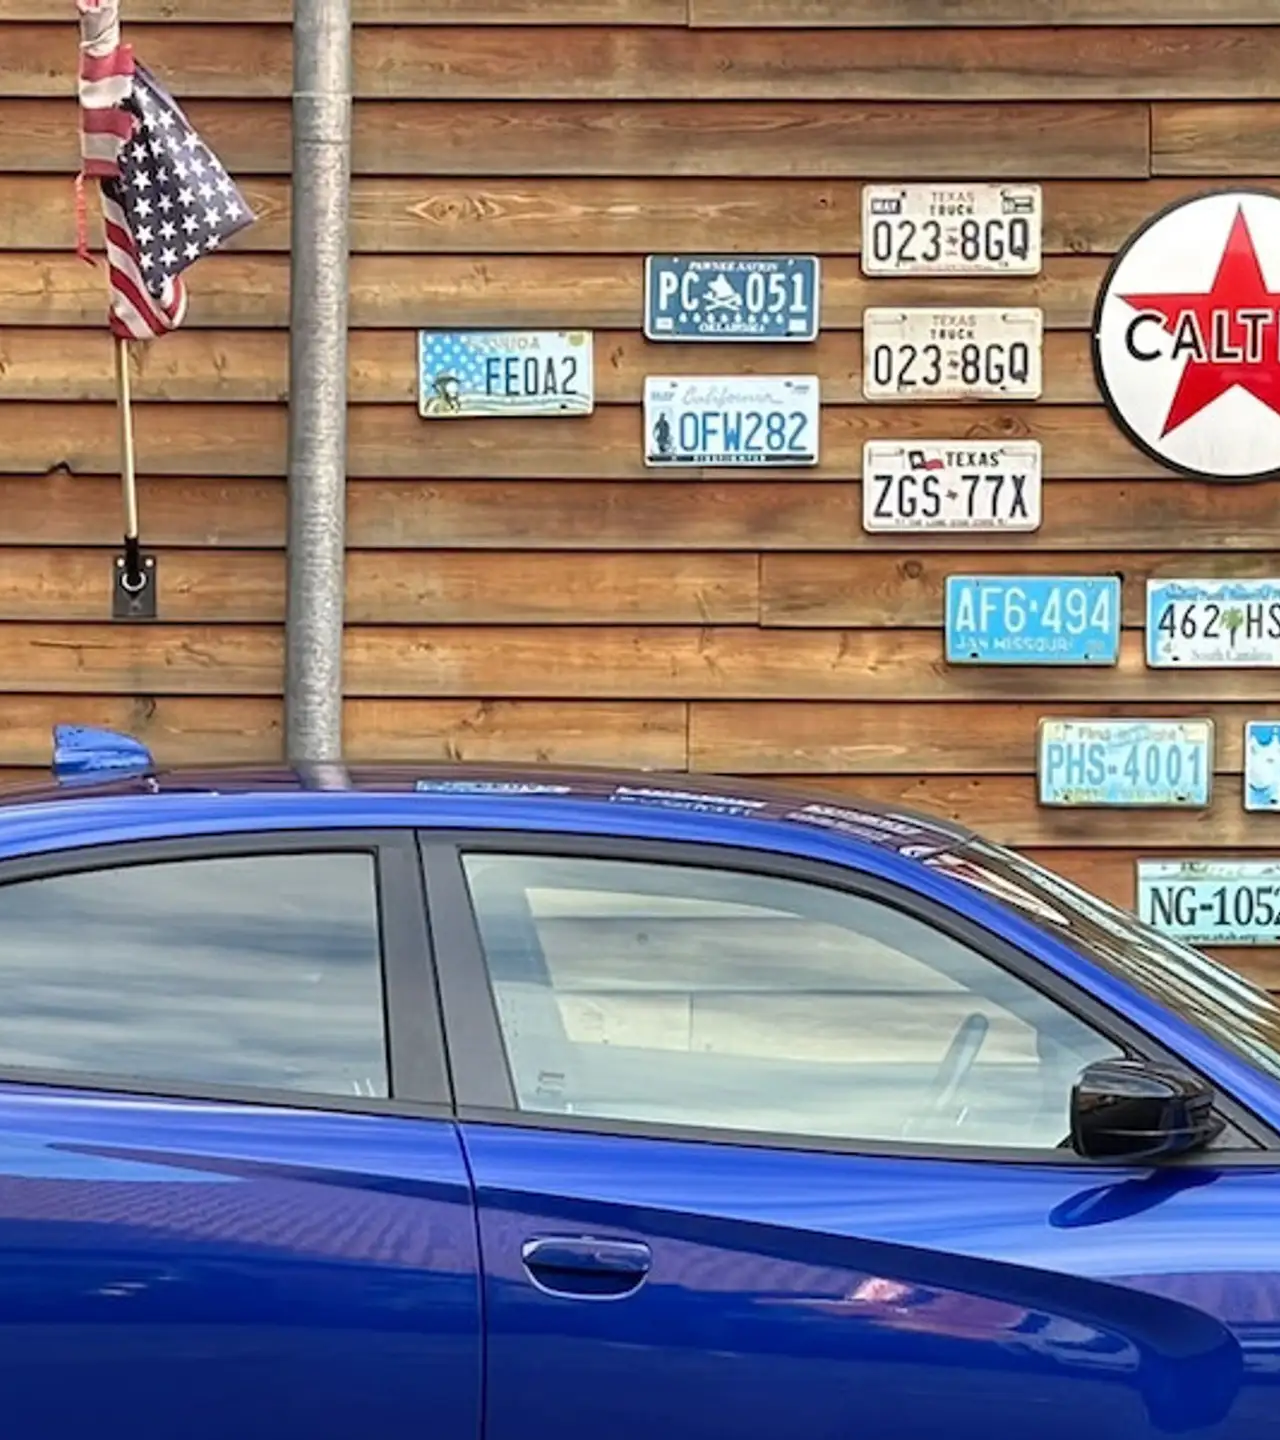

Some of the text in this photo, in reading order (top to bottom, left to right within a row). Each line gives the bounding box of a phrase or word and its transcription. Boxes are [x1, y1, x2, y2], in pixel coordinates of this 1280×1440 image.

[930, 204, 975, 216] TRUCK
[873, 218, 1029, 261] 023 8GQ
[659, 271, 808, 313] PC 051
[930, 329, 975, 339] TRUCK
[932, 314, 977, 326] TEXAS
[874, 342, 1029, 386] 023 8GQ
[945, 451, 1000, 467] TEXAS
[873, 475, 1029, 517] ZGS 77X
[1158, 603, 1220, 638] 462
